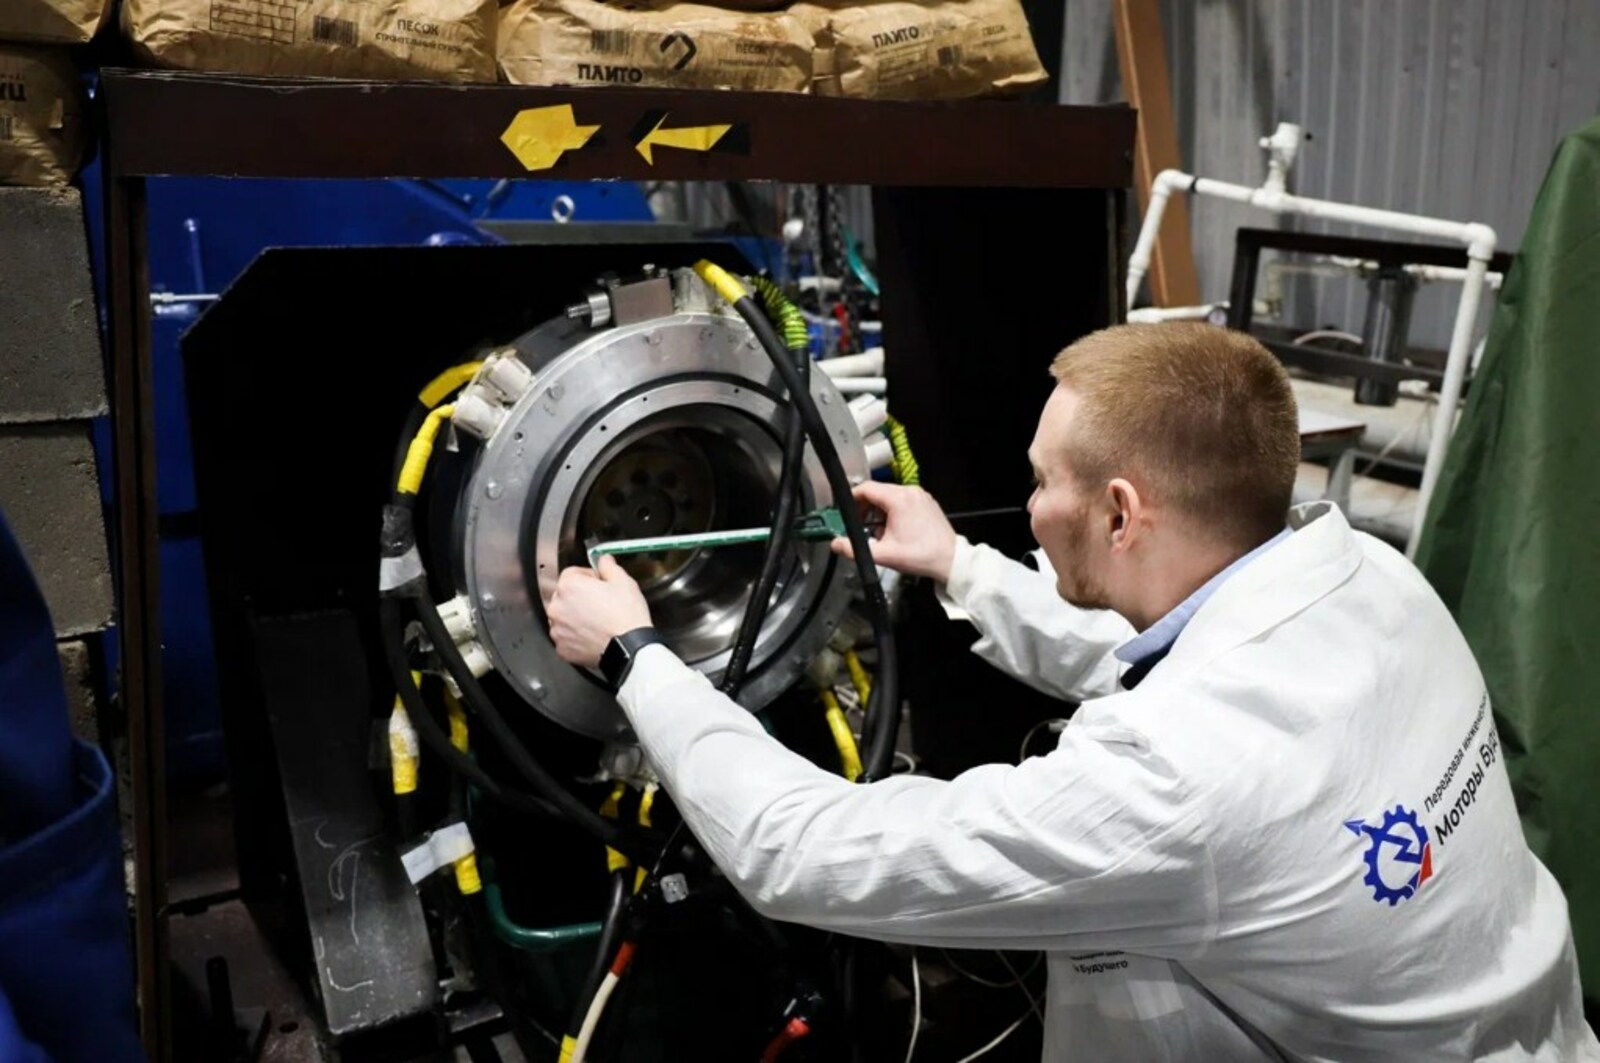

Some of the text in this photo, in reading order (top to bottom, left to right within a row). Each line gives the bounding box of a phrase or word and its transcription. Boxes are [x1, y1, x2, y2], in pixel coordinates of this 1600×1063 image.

[397, 19, 439, 36] ПЕСОК
[1424, 748, 1464, 813] Передовая
[1435, 763, 1484, 845] Моторы
